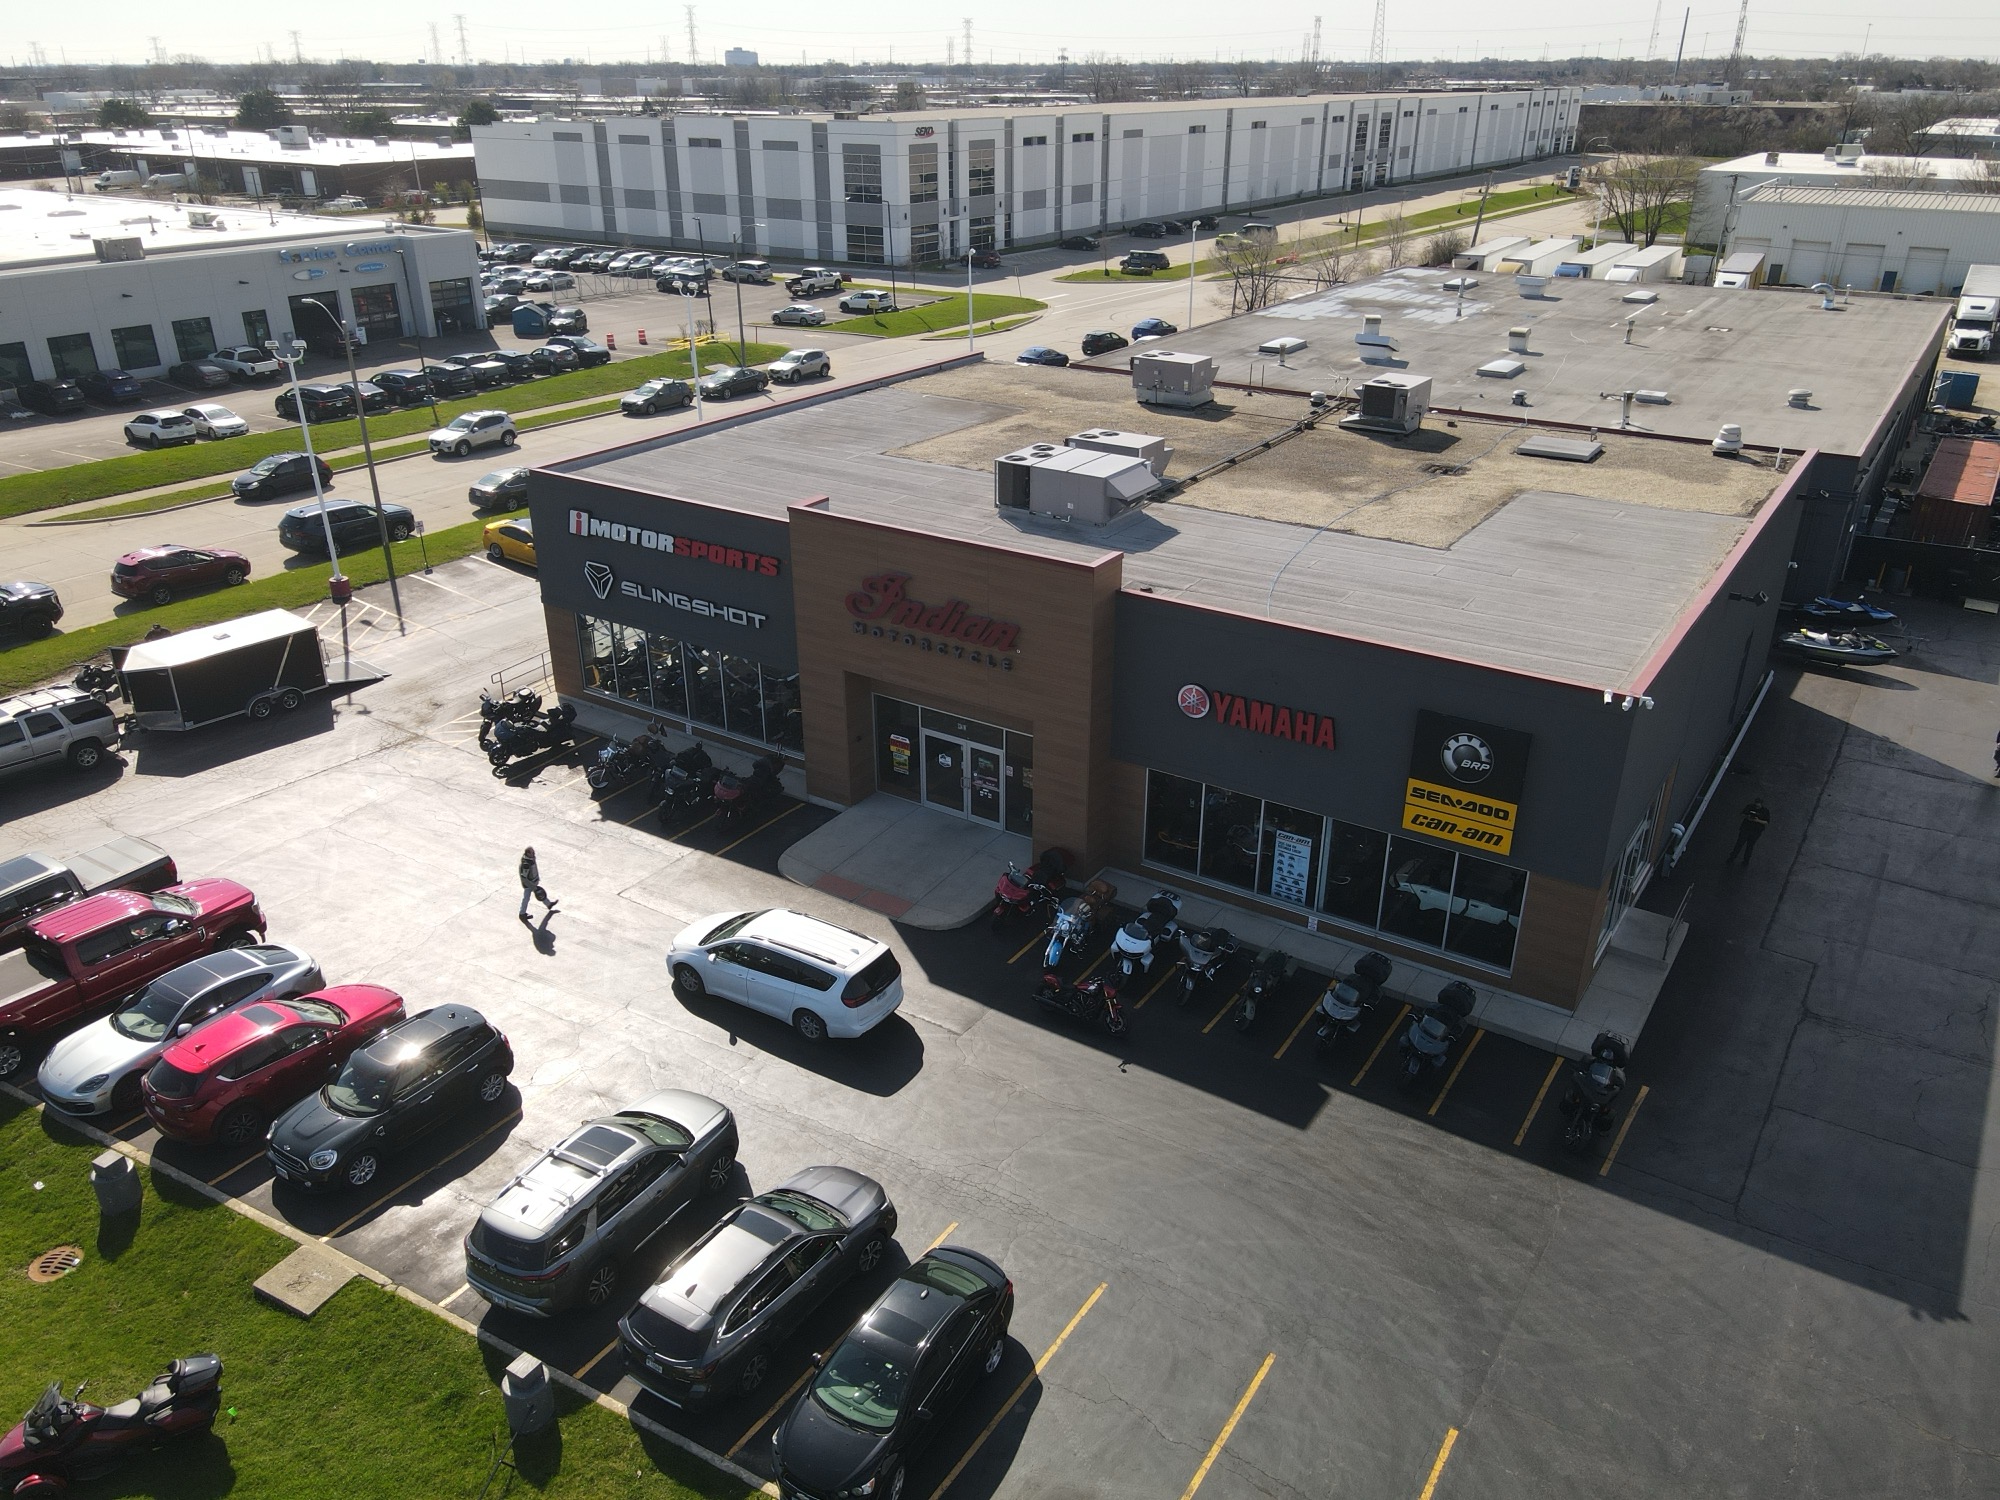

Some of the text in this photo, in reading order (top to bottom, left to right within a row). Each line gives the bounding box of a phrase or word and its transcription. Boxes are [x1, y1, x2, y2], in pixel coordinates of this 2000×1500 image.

[621, 580, 766, 629] SLINGSHOT
[845, 573, 1020, 651] Indian
[853, 621, 1013, 672] MOTORCYCLE
[1212, 691, 1336, 750] YAMAHA
[1461, 759, 1491, 771] BRP
[1411, 814, 1504, 847] can-am
